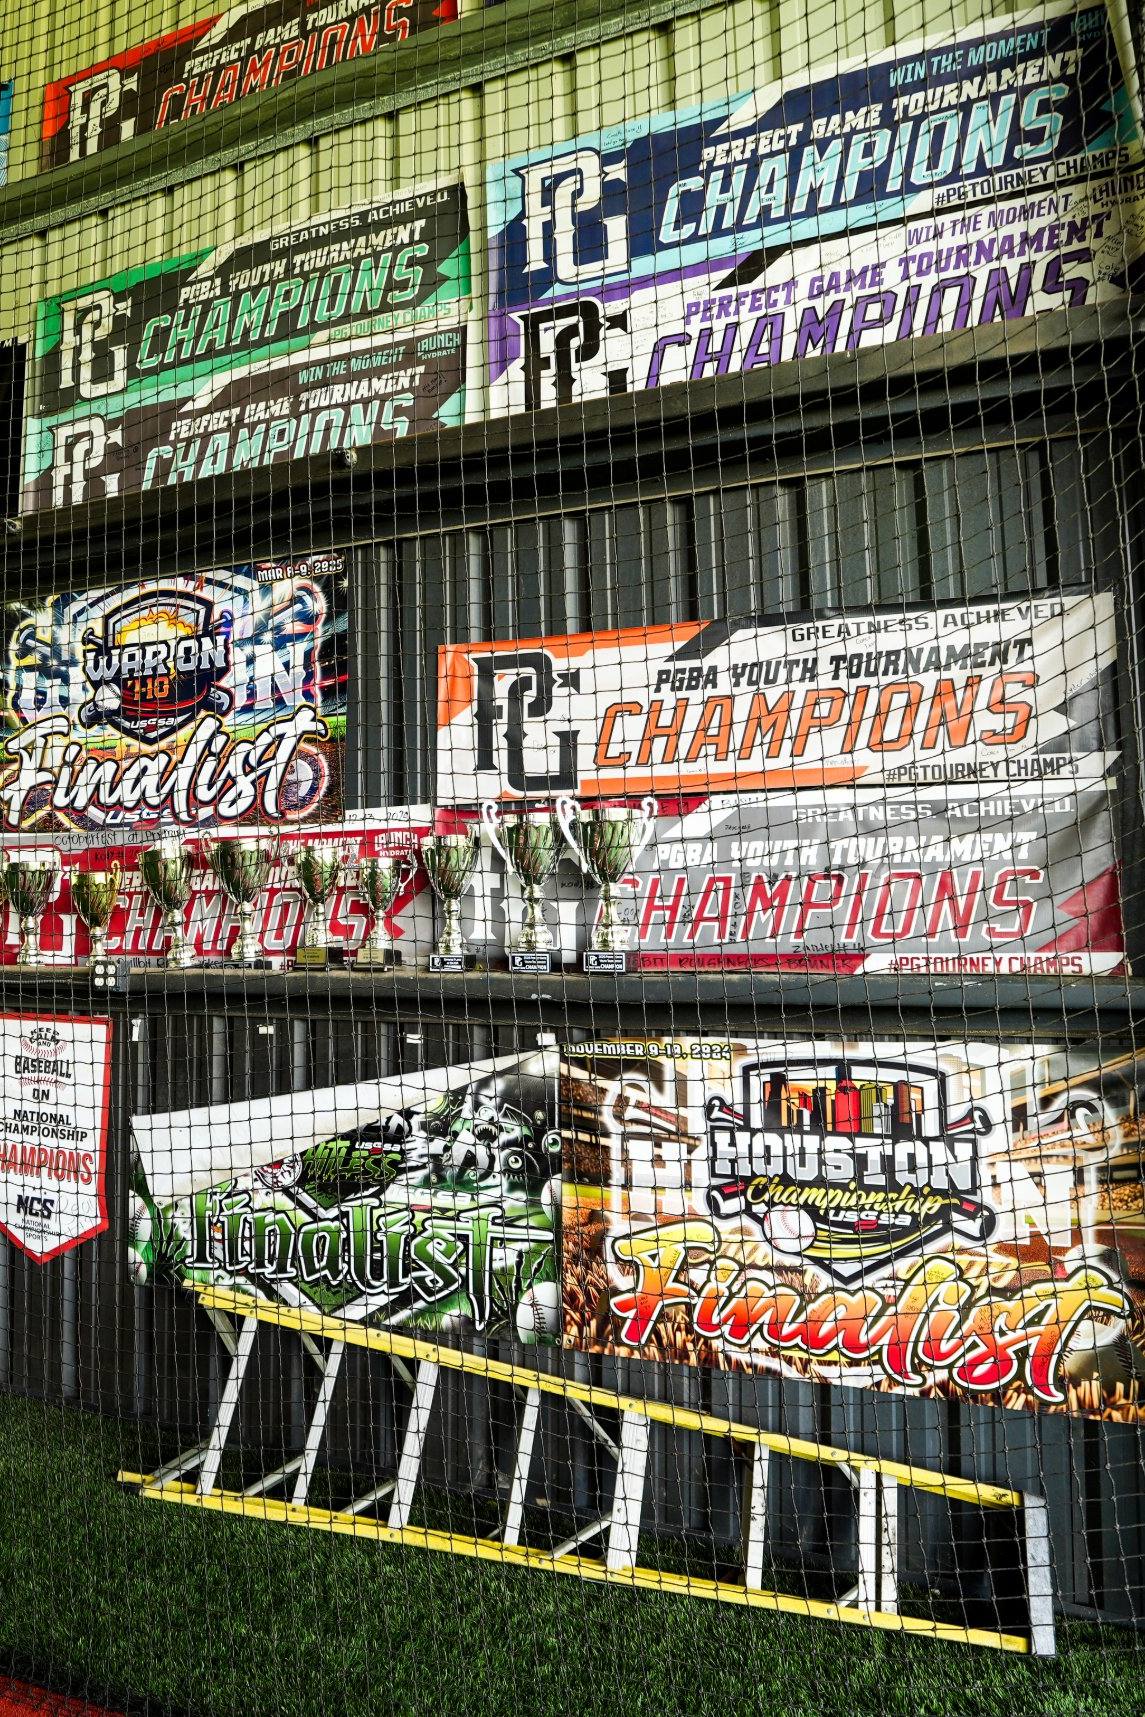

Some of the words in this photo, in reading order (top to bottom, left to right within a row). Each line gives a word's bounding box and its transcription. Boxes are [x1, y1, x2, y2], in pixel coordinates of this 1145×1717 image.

[155, 0, 413, 130] CHAMPIONS
[183, 37, 251, 78] PERFECT
[255, 17, 300, 50] GAME
[889, 60, 926, 88] WIN
[931, 51, 963, 77] THE
[967, 28, 1051, 66] MOMENT
[699, 123, 803, 171] PERFECT
[811, 103, 882, 139] GAME
[893, 49, 1083, 121] TOURNAMENT
[659, 83, 1070, 243] CHAMPIONS
[935, 165, 1049, 207] #PGTOURNEY
[1056, 147, 1130, 179] CHAMPS
[270, 215, 363, 251] GREATNESS.
[368, 190, 450, 223] ACHIEVED.
[907, 224, 944, 246] WIN
[951, 214, 982, 237] THE
[987, 193, 1072, 228] MOMENT
[179, 278, 221, 306] PGBA
[229, 258, 287, 292] YOUTH
[293, 219, 426, 274] TOURNAMENT
[686, 281, 798, 325] PERFECT
[808, 261, 886, 300] GAME
[898, 210, 1112, 280] TOURNAMENT
[136, 243, 429, 369] CHAMPIONS
[645, 247, 1096, 389] CHAMPIONS
[299, 367, 324, 384] WIN
[326, 360, 347, 378] THE
[350, 346, 405, 372] MOMENT
[421, 348, 456, 361] HYDRATE
[169, 407, 240, 441] PERFECT
[244, 396, 294, 424] GAME
[299, 365, 425, 411] TOURNAMENT
[142, 393, 415, 490] CHAMPIONS
[257, 568, 283, 582] MAR
[792, 616, 933, 643] GREATNESS.
[943, 602, 1070, 628] ACHIEVED.
[84, 641, 170, 681] WAR
[175, 635, 227, 672] ON
[654, 666, 717, 693] PGBA
[731, 656, 818, 688] YOUTH
[830, 638, 1032, 682] TOURNAMENT
[593, 671, 1040, 767] CHAMPIONS
[1, 704, 329, 827] Finalist
[886, 761, 1006, 783] #PGTOURNEY
[1008, 757, 1079, 779] CHAMPS
[792, 803, 935, 824] GREATNESS.
[946, 797, 1074, 818] ACHIEVED.
[374, 831, 418, 852] LAUNCH
[653, 842, 718, 870] PGBA
[731, 838, 821, 867] YOUTH
[830, 831, 1037, 866] TOURNAMENT
[888, 955, 1002, 974] #PGTOURNEY
[1008, 955, 1083, 975] CHAMPS
[14, 1055, 72, 1079] BASEBALL
[32, 1088, 50, 1101] ON
[13, 1109, 72, 1126] NATIONAL
[714, 1131, 977, 1191] HOUSTON
[16, 1194, 55, 1220] NCS
[747, 1175, 960, 1221] Championship
[610, 1226, 1131, 1402] Finalist
